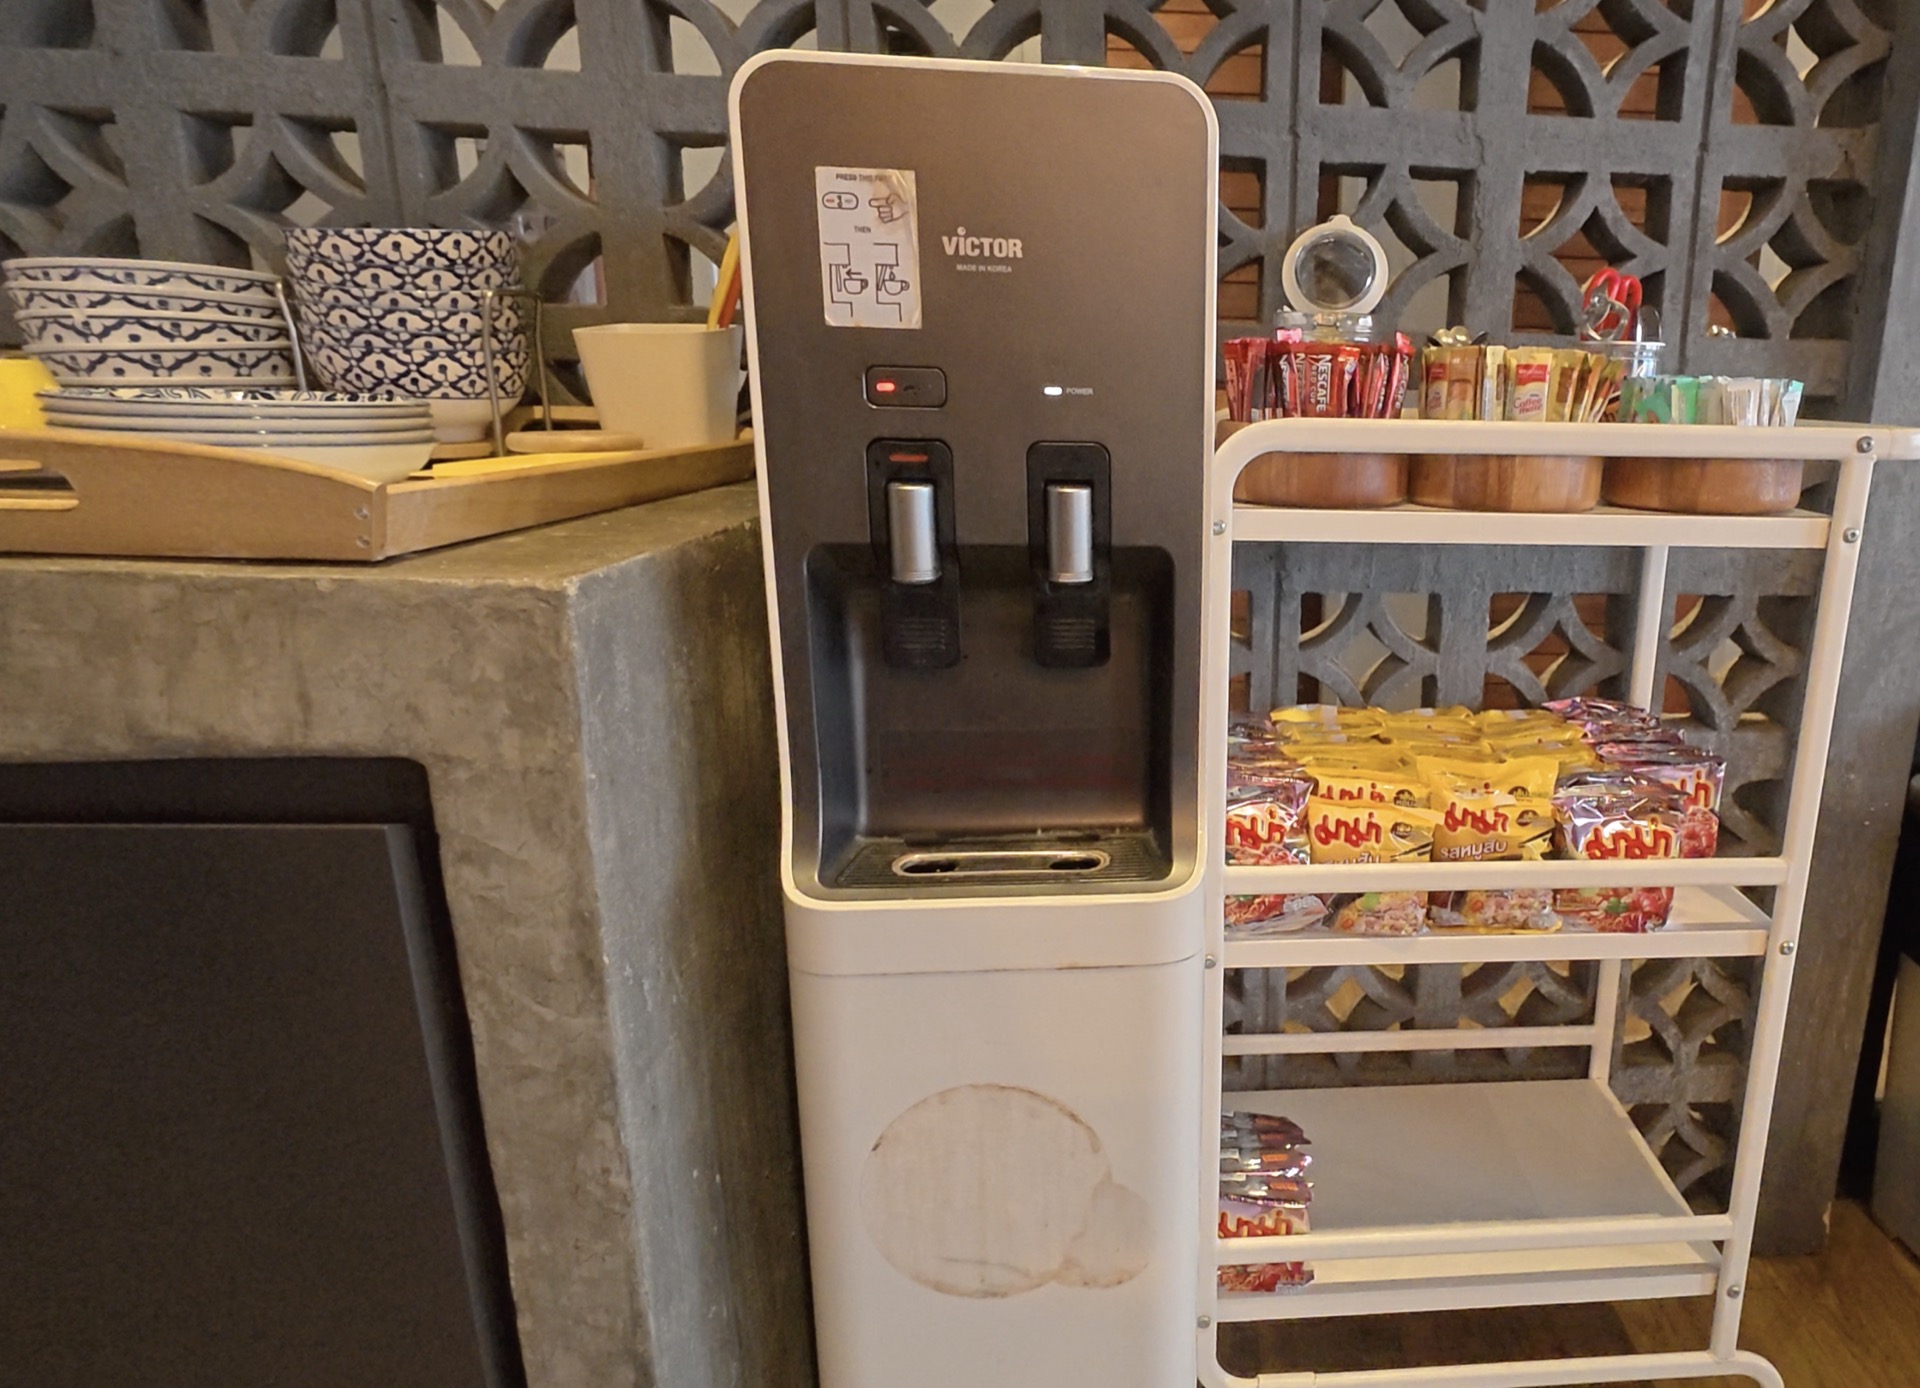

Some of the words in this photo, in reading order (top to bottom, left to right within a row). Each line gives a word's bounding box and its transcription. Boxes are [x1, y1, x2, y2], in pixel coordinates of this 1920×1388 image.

[836, 173, 857, 181] PRESS
[956, 264, 977, 272] MADE
[987, 265, 1013, 273] KOREA
[1066, 388, 1094, 396] POWER
